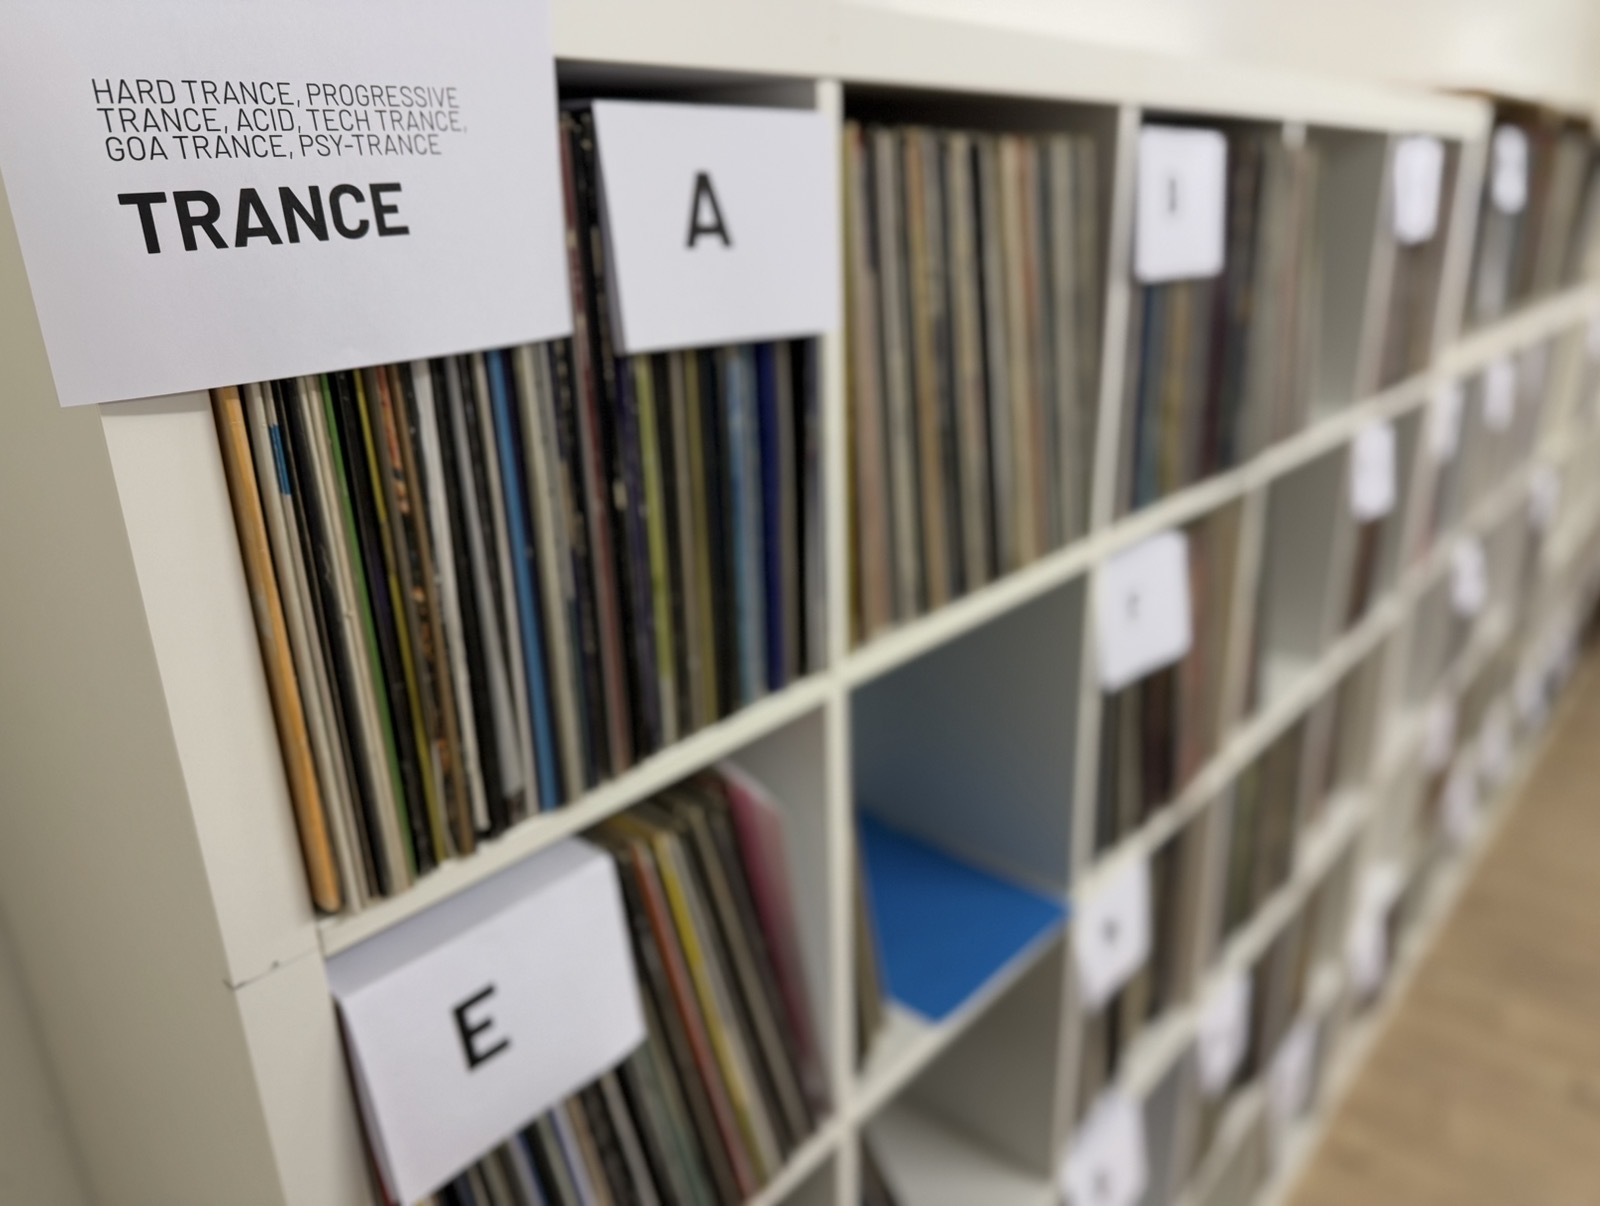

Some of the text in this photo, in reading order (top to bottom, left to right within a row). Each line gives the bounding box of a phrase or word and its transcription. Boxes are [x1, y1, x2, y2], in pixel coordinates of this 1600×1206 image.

[91, 78, 460, 110] HARD TRANCE, PROGRESSIVE
[96, 107, 468, 135] TRANCE, ACID, TECH TRANCE,
[104, 132, 443, 162] GOA TRANCE, PSY-TRANCE
[116, 181, 411, 255] TRANCE
[685, 170, 733, 250] A
[451, 983, 511, 1073] E
